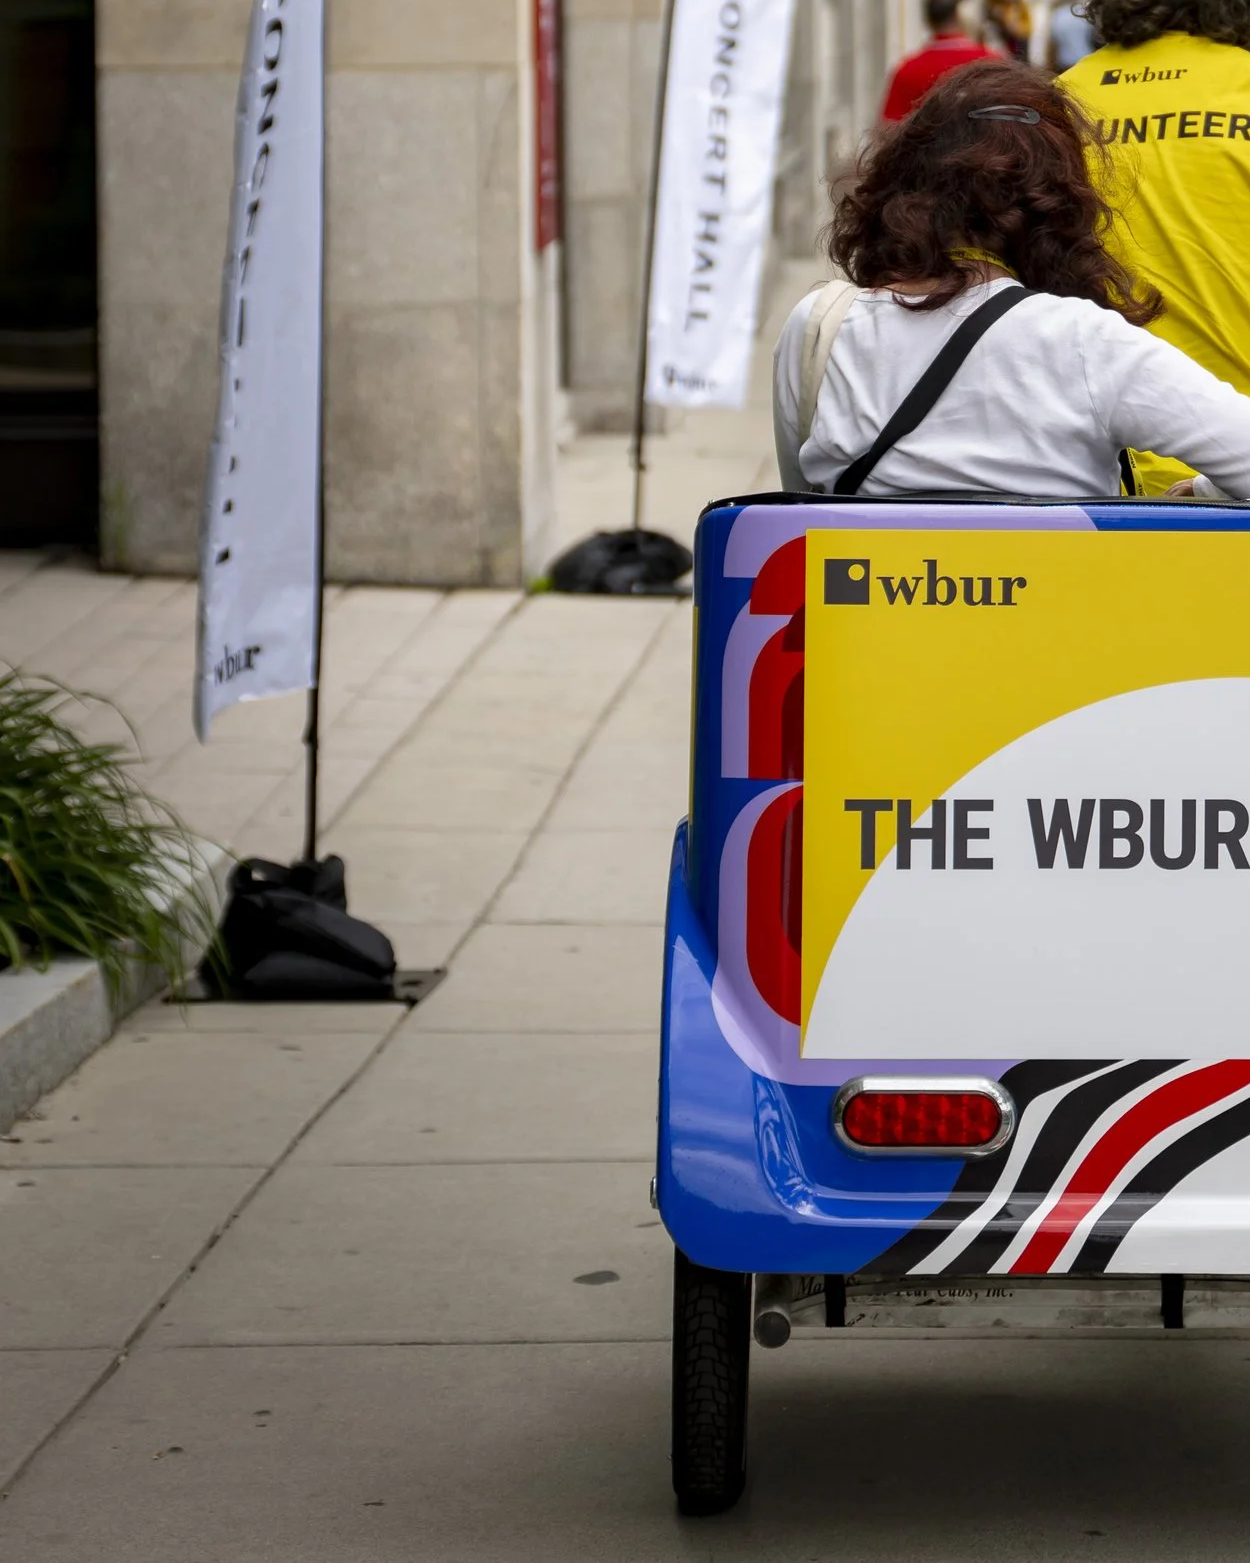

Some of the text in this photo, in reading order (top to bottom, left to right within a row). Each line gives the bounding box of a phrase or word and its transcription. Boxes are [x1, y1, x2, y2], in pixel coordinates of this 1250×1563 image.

[1123, 66, 1188, 84] wbur
[684, 211, 721, 334] HALL
[876, 559, 1027, 607] wbur
[844, 798, 994, 871] THE
[1027, 798, 1250, 871] WBUR
